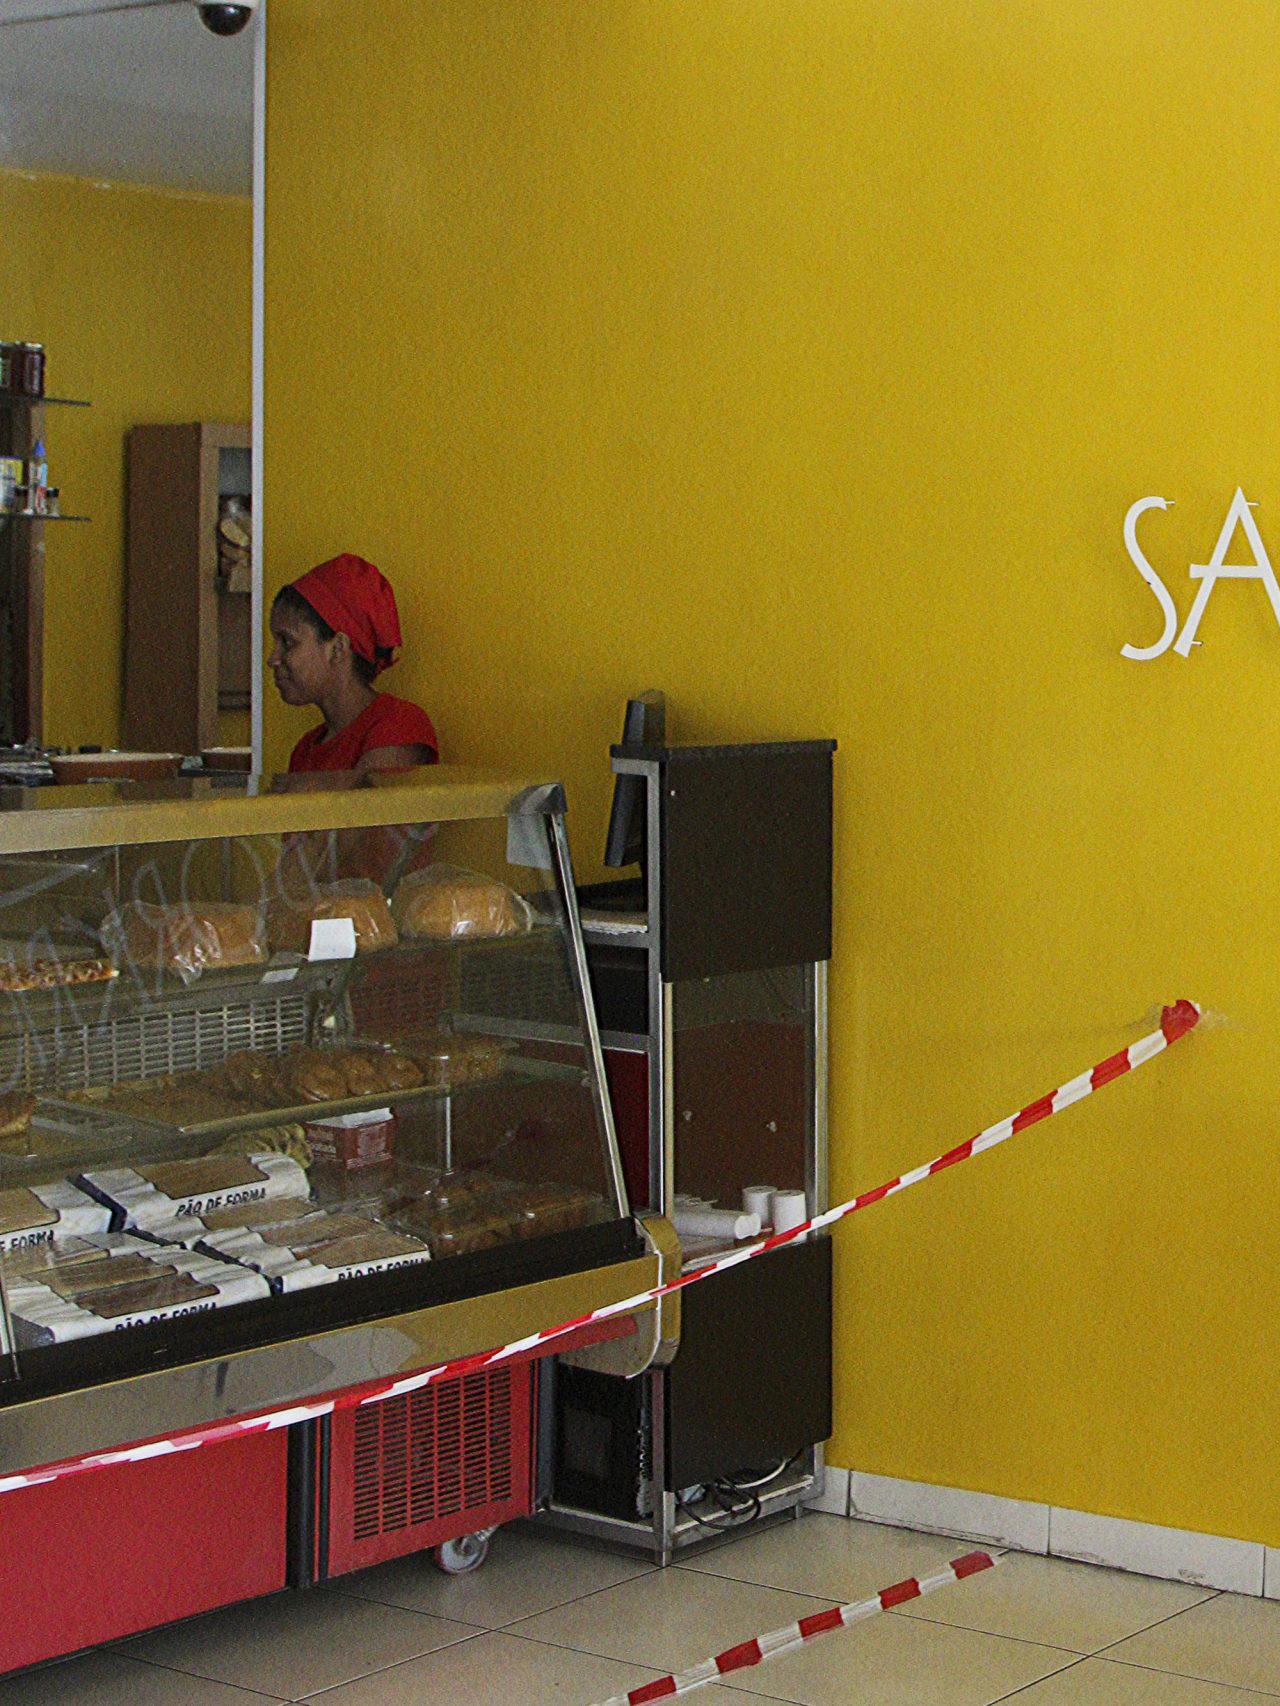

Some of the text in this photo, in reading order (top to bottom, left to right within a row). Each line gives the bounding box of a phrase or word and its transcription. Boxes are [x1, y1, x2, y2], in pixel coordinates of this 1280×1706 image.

[175, 1187, 267, 1217] PÃO DE FORMA
[11, 1229, 54, 1249] FORMA
